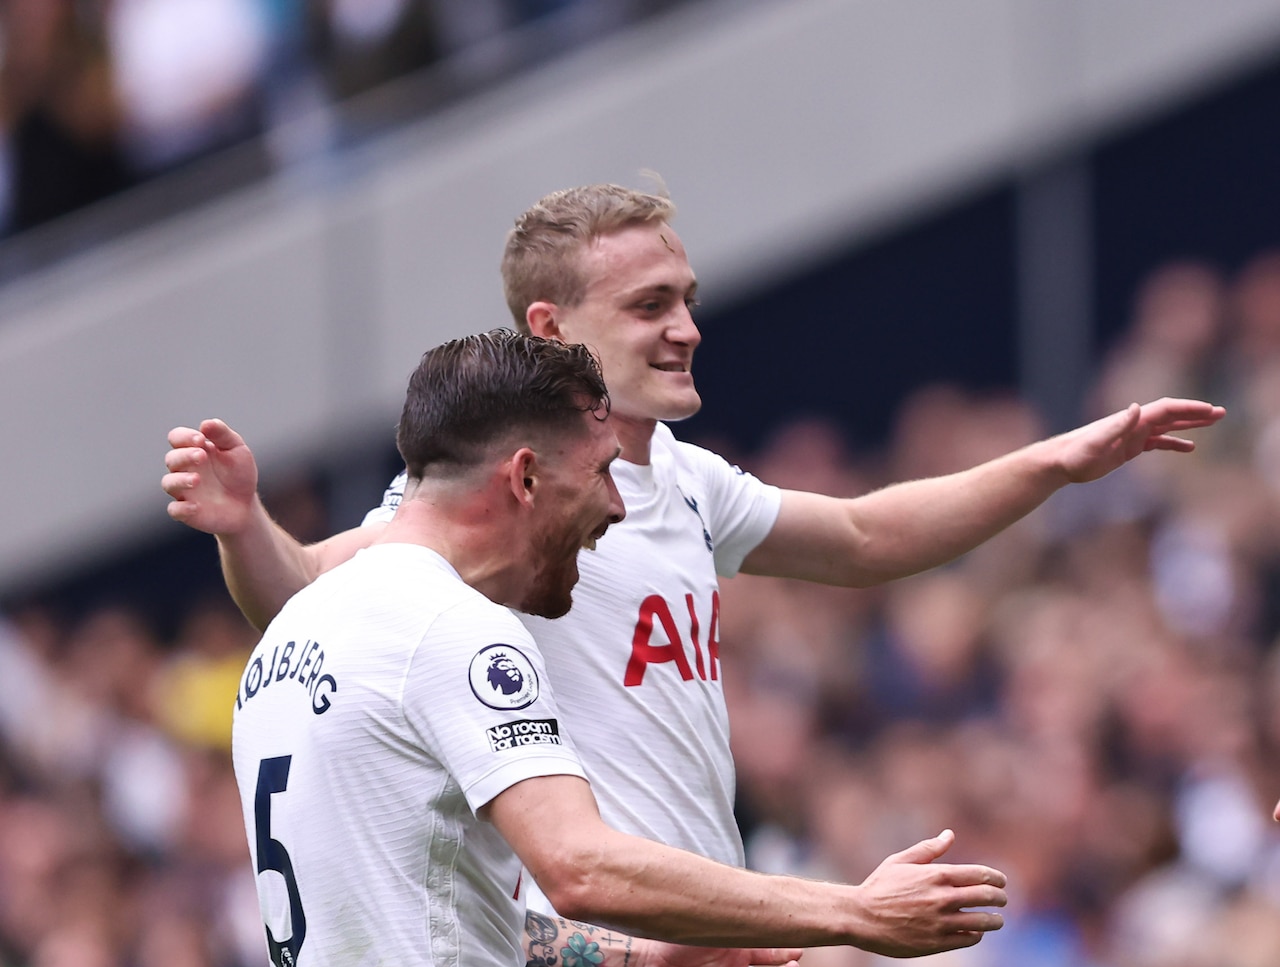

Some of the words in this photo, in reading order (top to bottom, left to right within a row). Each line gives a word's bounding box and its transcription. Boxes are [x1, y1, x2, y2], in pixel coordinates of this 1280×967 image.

[487, 726, 511, 741] No
[512, 721, 552, 736] room
[491, 738, 516, 752] for
[515, 733, 561, 747] racism
